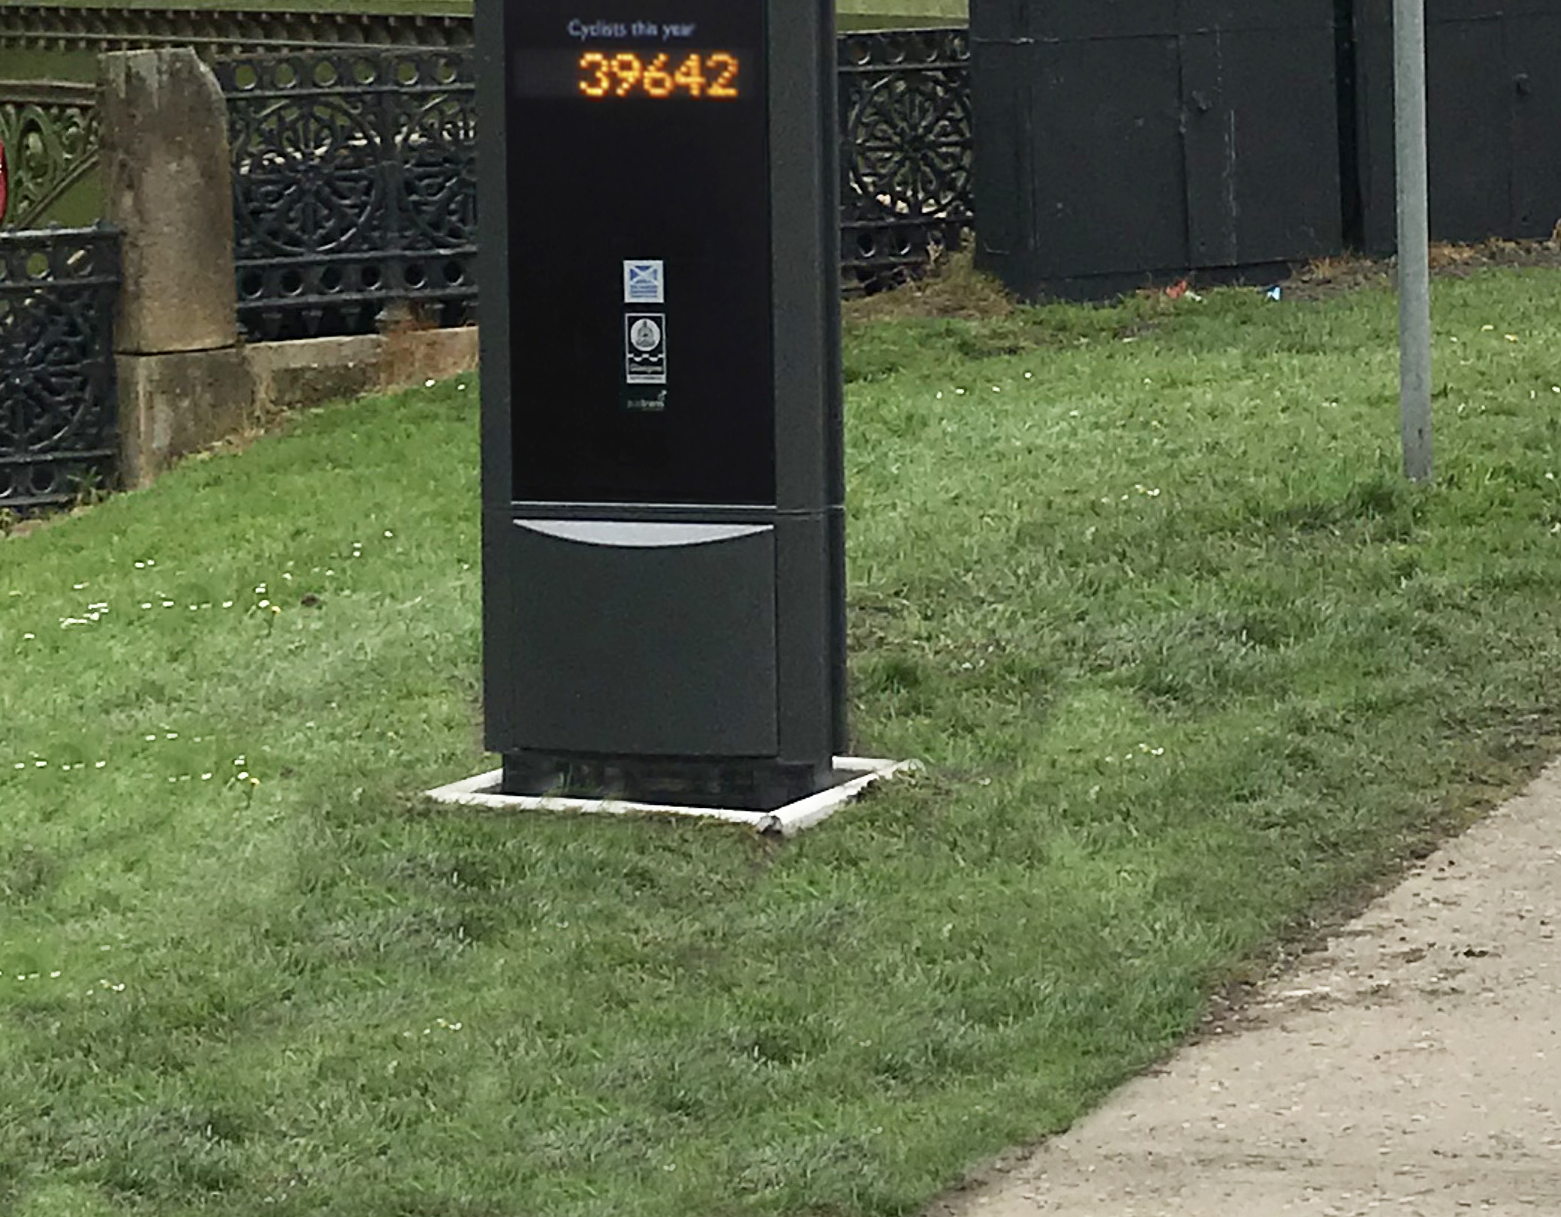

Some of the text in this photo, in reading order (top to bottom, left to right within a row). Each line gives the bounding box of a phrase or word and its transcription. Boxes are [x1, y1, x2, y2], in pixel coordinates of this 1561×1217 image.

[567, 19, 696, 42] Cyclists this year
[579, 51, 739, 98] 39642
